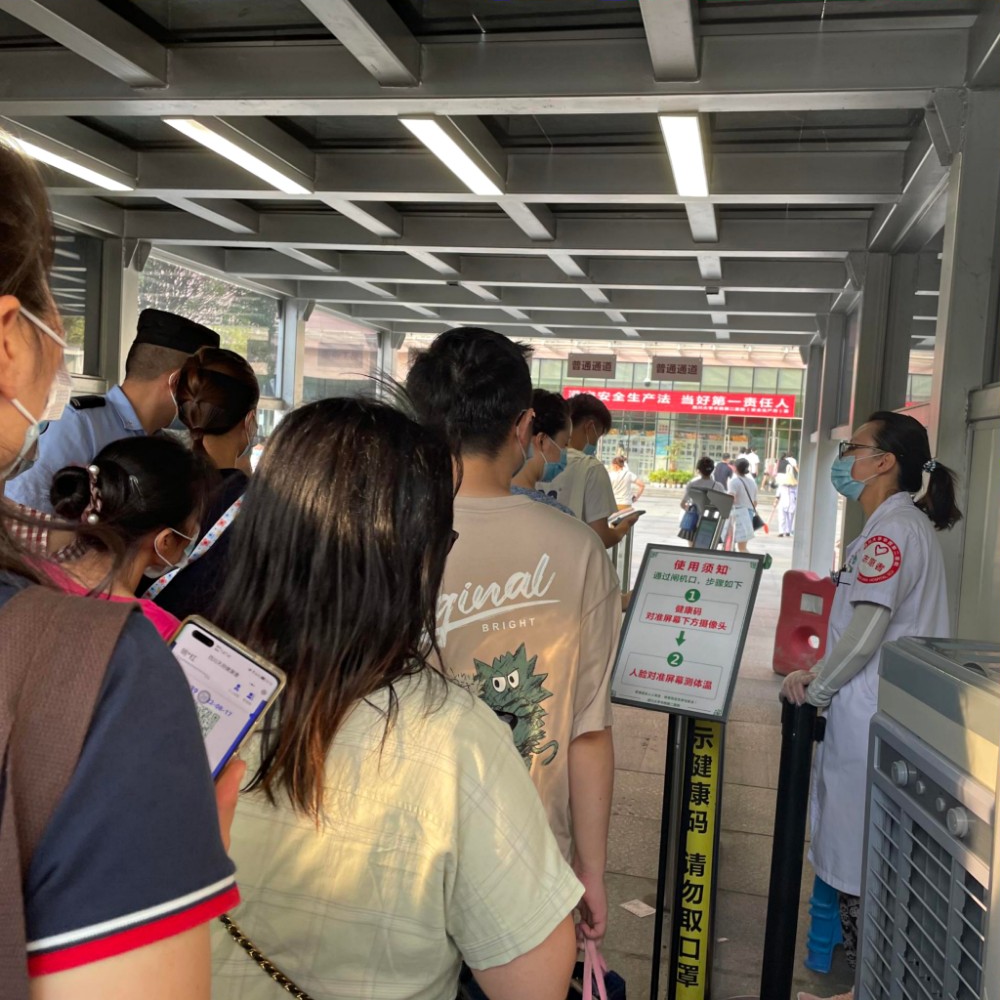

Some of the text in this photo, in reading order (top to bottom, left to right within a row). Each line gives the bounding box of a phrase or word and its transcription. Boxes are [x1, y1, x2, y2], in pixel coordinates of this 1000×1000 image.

[572, 360, 612, 372] 普通通道
[656, 363, 698, 375] 普通通道
[568, 389, 790, 409] 安全生产法 当好第一责任人
[674, 560, 729, 575] 使用须知
[675, 605, 702, 616] 健康码
[482, 617, 536, 632] BRIGHT
[645, 612, 727, 631] 对准屏幕下方摄像头
[629, 668, 712, 690] 人脸对准屏幕测体温
